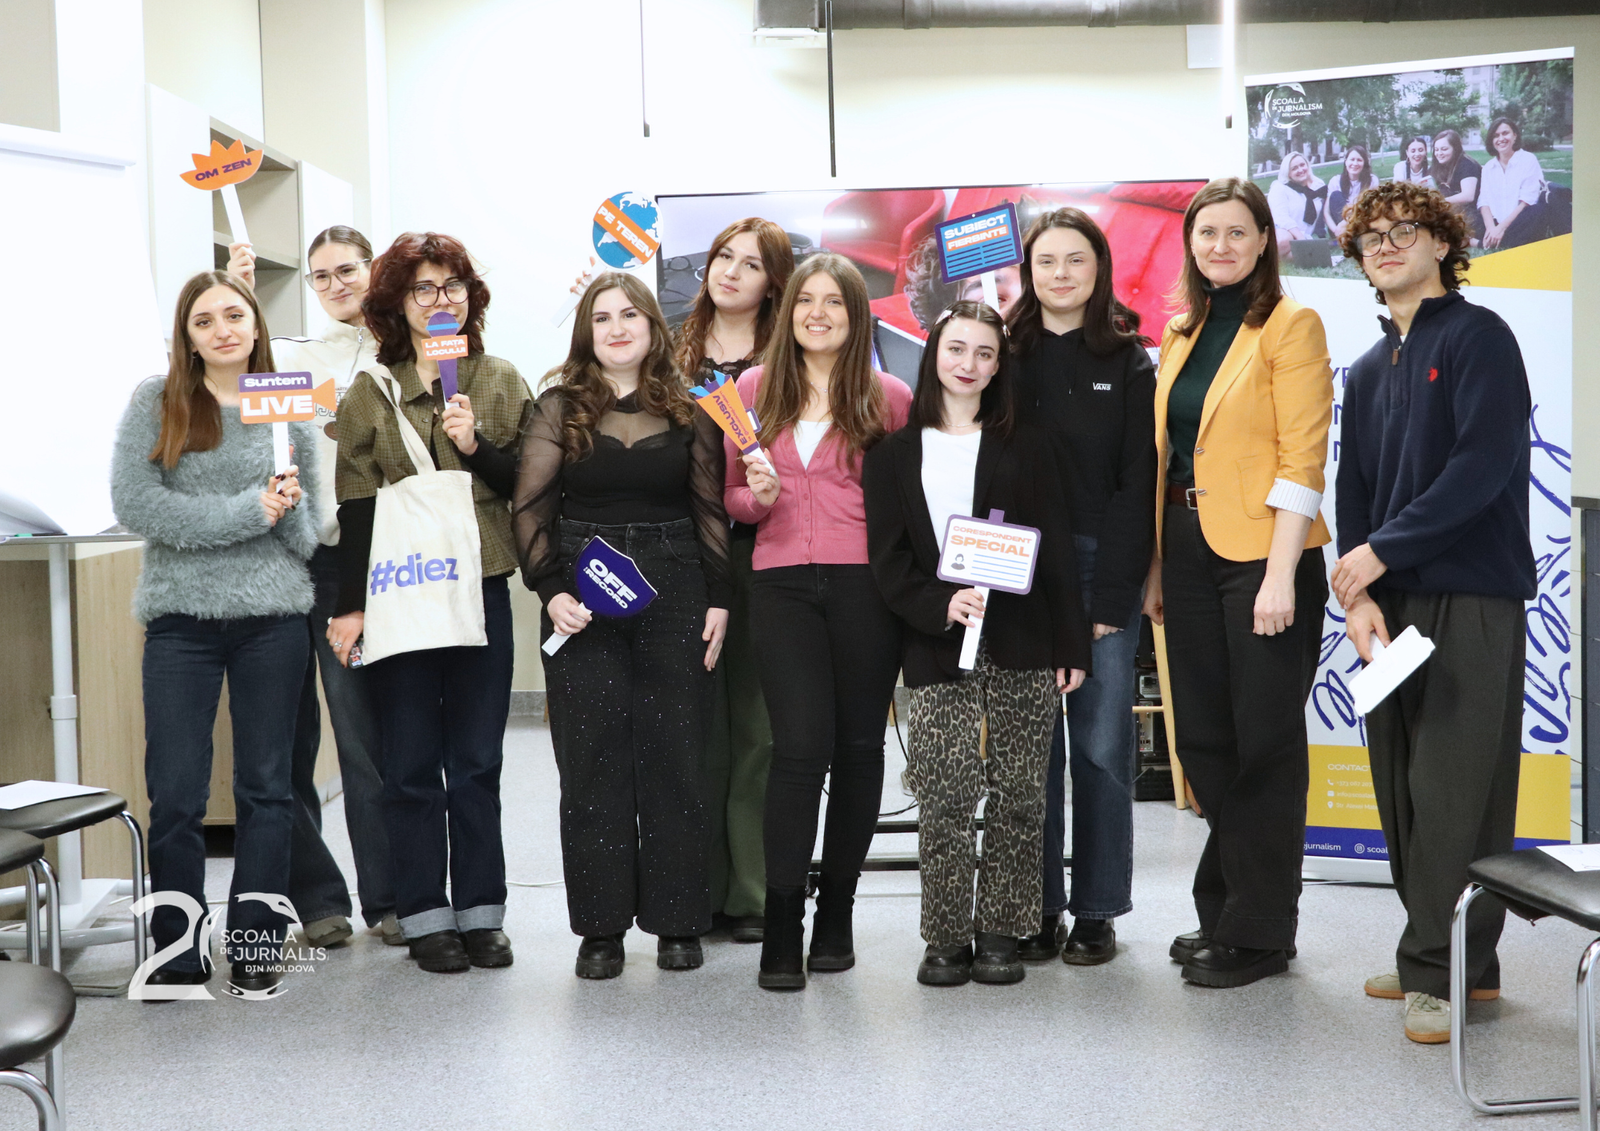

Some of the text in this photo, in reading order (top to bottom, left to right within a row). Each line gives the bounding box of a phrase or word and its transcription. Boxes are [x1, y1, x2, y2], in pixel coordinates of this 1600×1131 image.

[1277, 103, 1323, 113] JURNALISM
[195, 158, 252, 181] OM ZEN
[597, 205, 654, 258] PE TEREN
[944, 213, 1007, 239] SUBIECT
[947, 226, 1007, 250] FIERBINTE
[426, 347, 466, 356] LOCULUI
[244, 376, 307, 387] Suntem
[1092, 382, 1112, 391] VANS
[242, 395, 313, 416] LIVE
[712, 394, 748, 445] EXCLUSIV
[950, 535, 1030, 558] SPECIAL
[953, 526, 1032, 544] CORESPONDENT
[370, 552, 459, 596] #diez
[589, 558, 638, 602] OFF
[585, 568, 628, 609] RECORD
